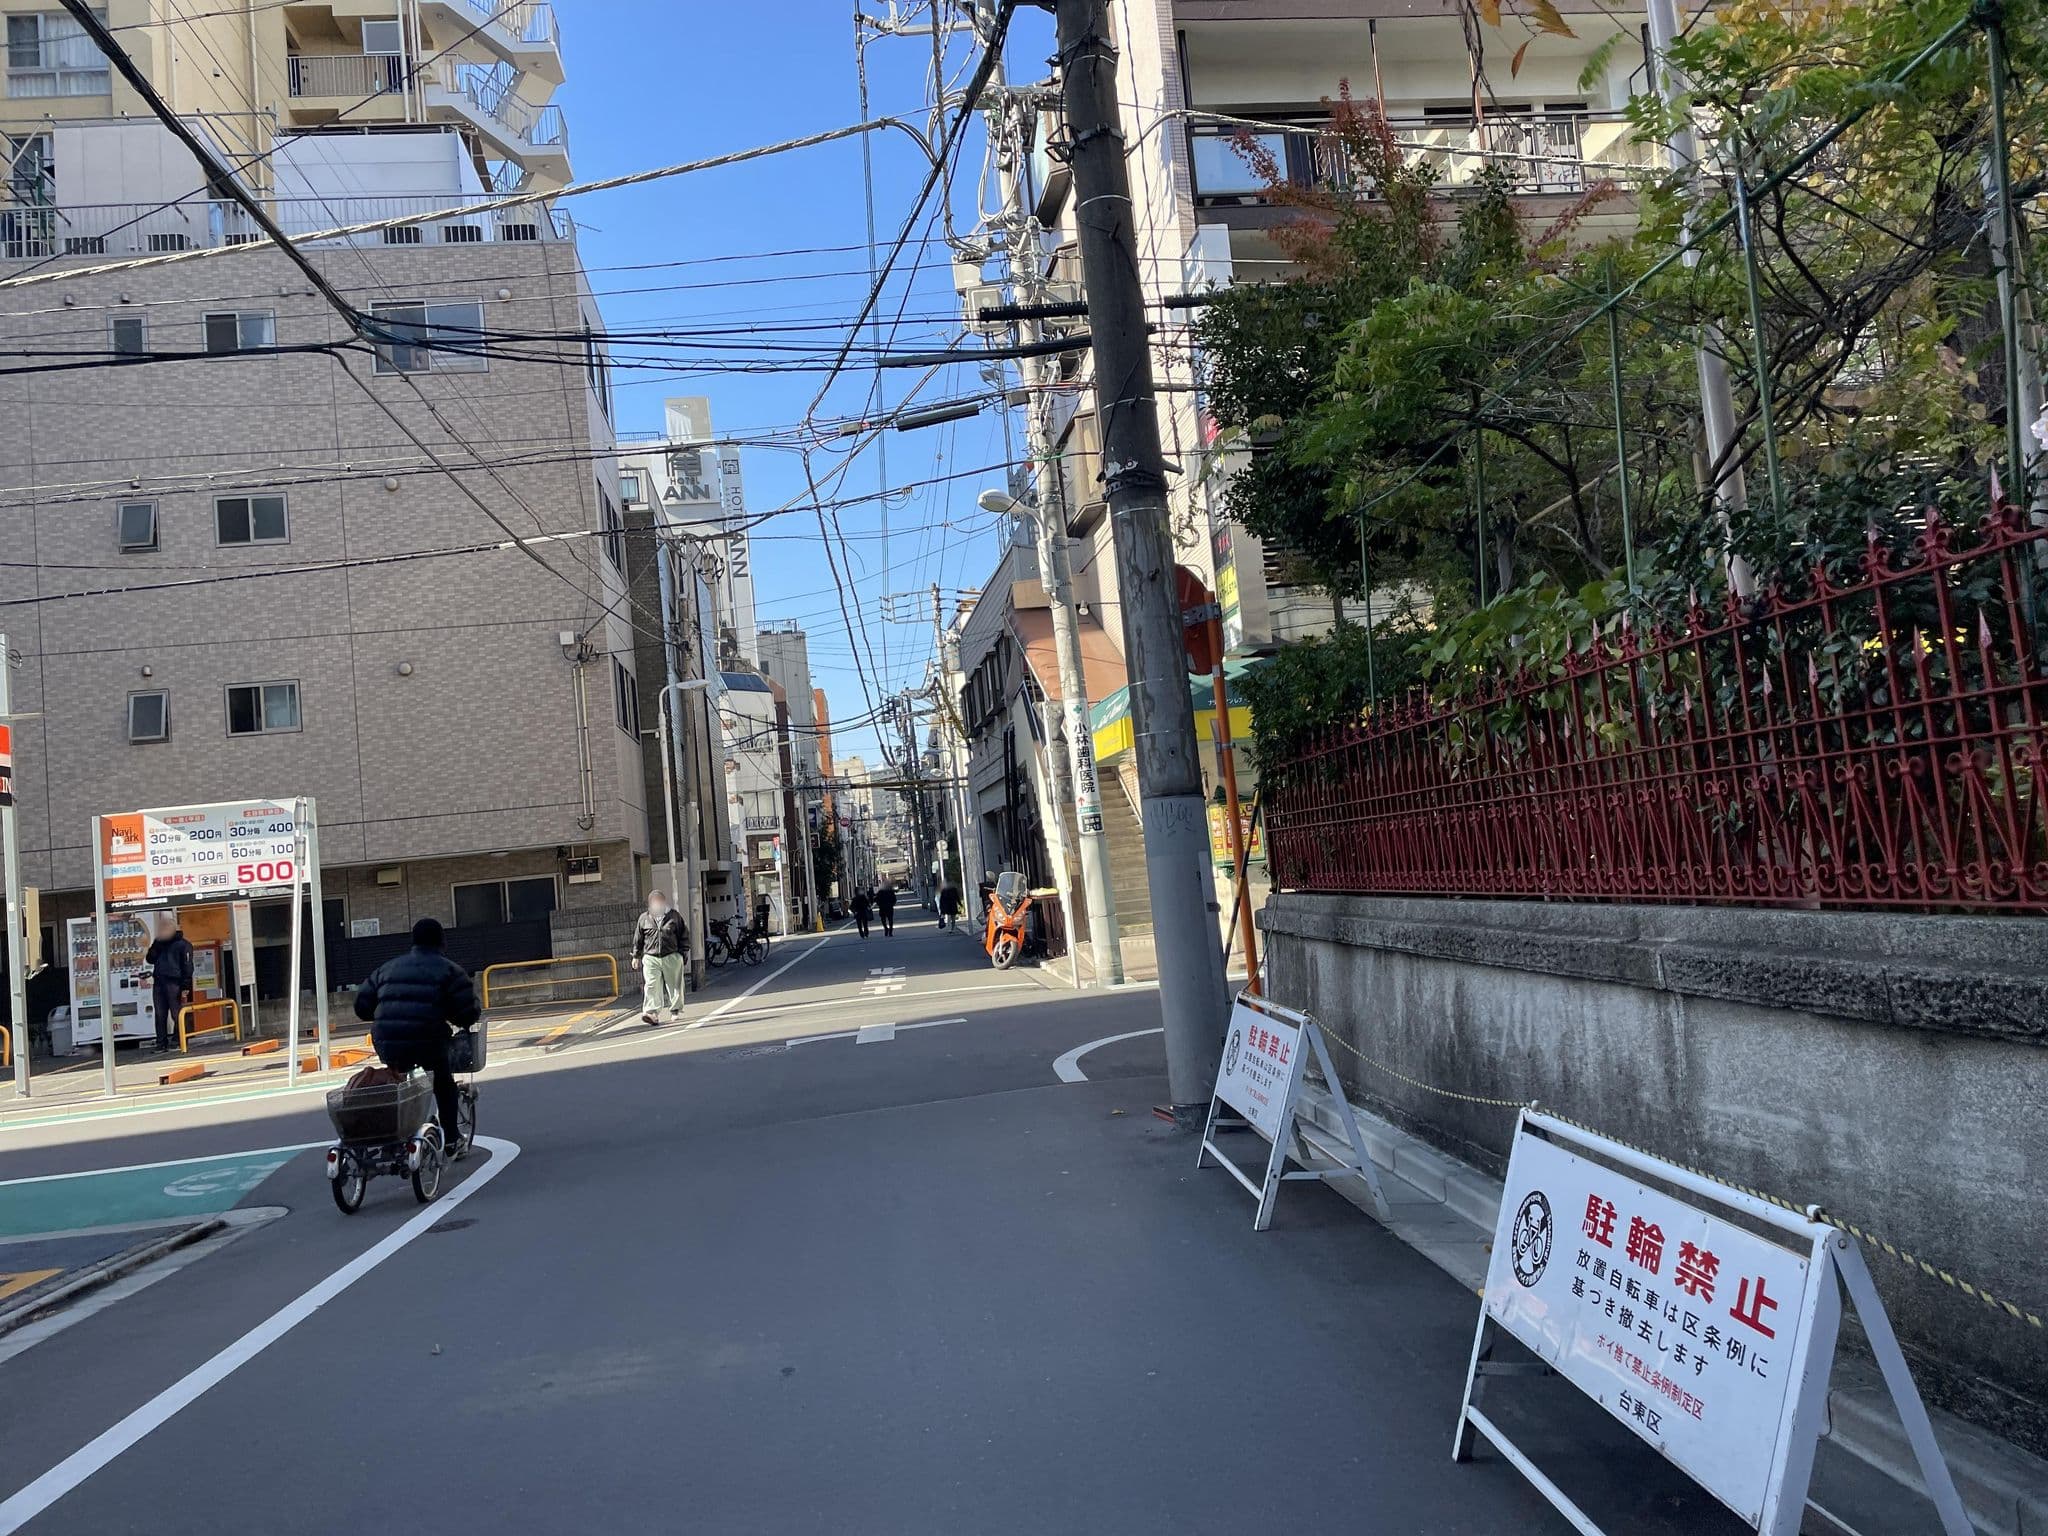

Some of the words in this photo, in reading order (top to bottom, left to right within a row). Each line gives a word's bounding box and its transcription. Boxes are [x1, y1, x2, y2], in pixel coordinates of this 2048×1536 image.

[663, 485, 710, 501] ANN
[670, 477, 700, 485] HOTEL
[729, 532, 748, 578] ANN
[1074, 722, 1096, 793] 小林歯科医院
[112, 827, 132, 837] Navi
[150, 834, 181, 844] 30分毎
[189, 829, 222, 840] 200円
[230, 827, 261, 837] 30分毎
[268, 822, 293, 833] 400
[152, 855, 183, 865] 60分毎
[192, 851, 223, 862] 100円
[231, 848, 262, 858] 60分毎
[271, 844, 293, 854] 100
[152, 874, 196, 887] 夜間最大
[201, 874, 227, 886] 全曜日
[237, 861, 304, 884] 500
[1247, 1024, 1291, 1065] 駐輪禁止
[1581, 1193, 1779, 1340] 駐輪禁止
[1570, 1275, 1710, 1377] 基づき撤去します
[1575, 1248, 1768, 1379] 放置自転車は区条例に
[1619, 1390, 1662, 1435] 台東区
